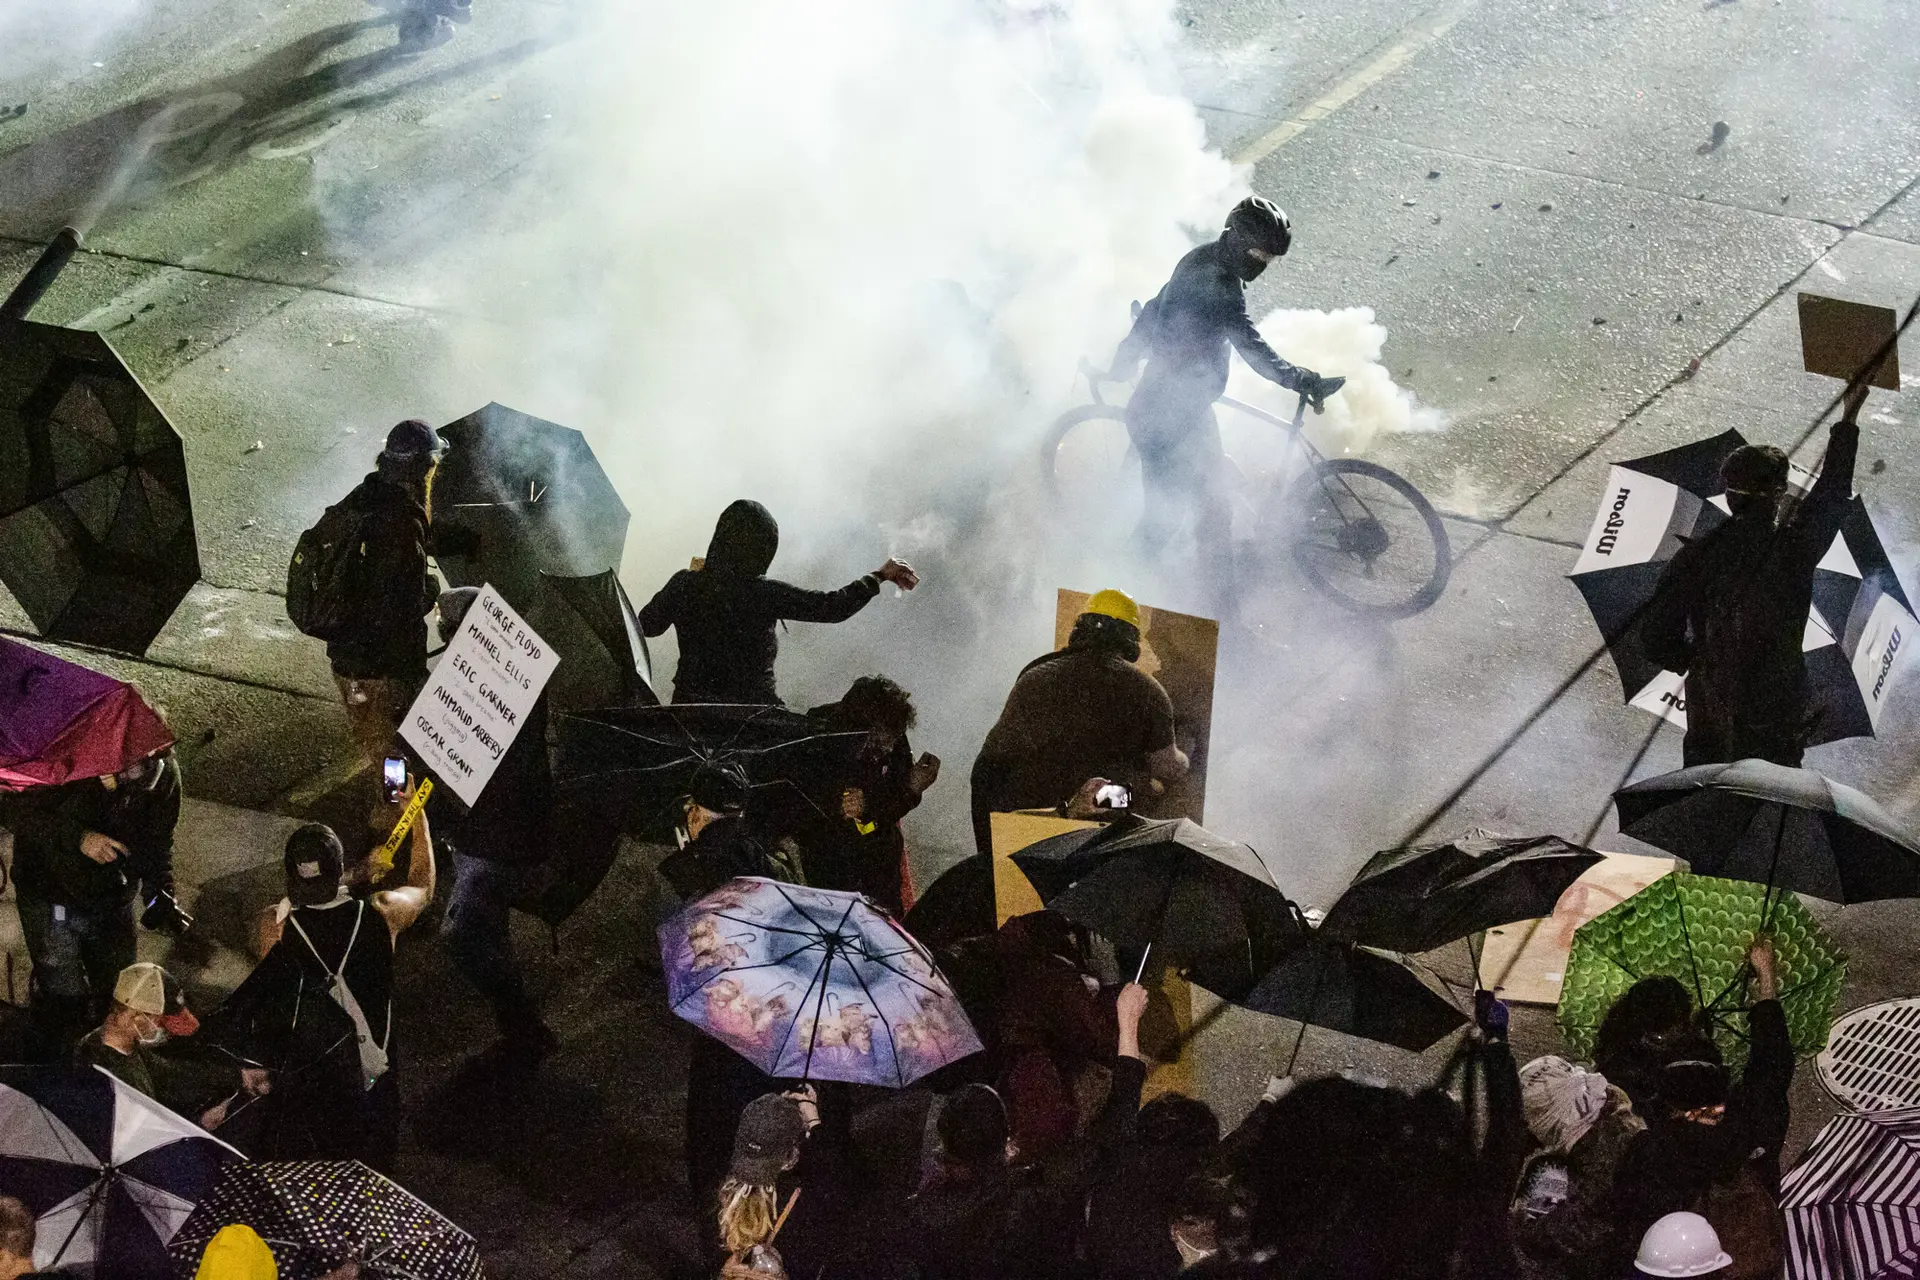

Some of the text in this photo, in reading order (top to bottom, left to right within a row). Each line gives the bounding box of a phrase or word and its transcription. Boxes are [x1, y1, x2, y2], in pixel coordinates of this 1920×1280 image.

[467, 622, 501, 664] MANUEL
[504, 659, 531, 689] ELLIS
[482, 595, 515, 634] GEORGE
[514, 629, 541, 660] FLOYD
[452, 653, 476, 684] ERIC
[478, 682, 516, 726] GARNER
[416, 715, 474, 777] OSCAR GRANT
[433, 685, 473, 726] AHMAUD
[470, 723, 504, 761] ARBERY
[402, 803, 420, 825] THEIR
[417, 781, 430, 803] SAY
